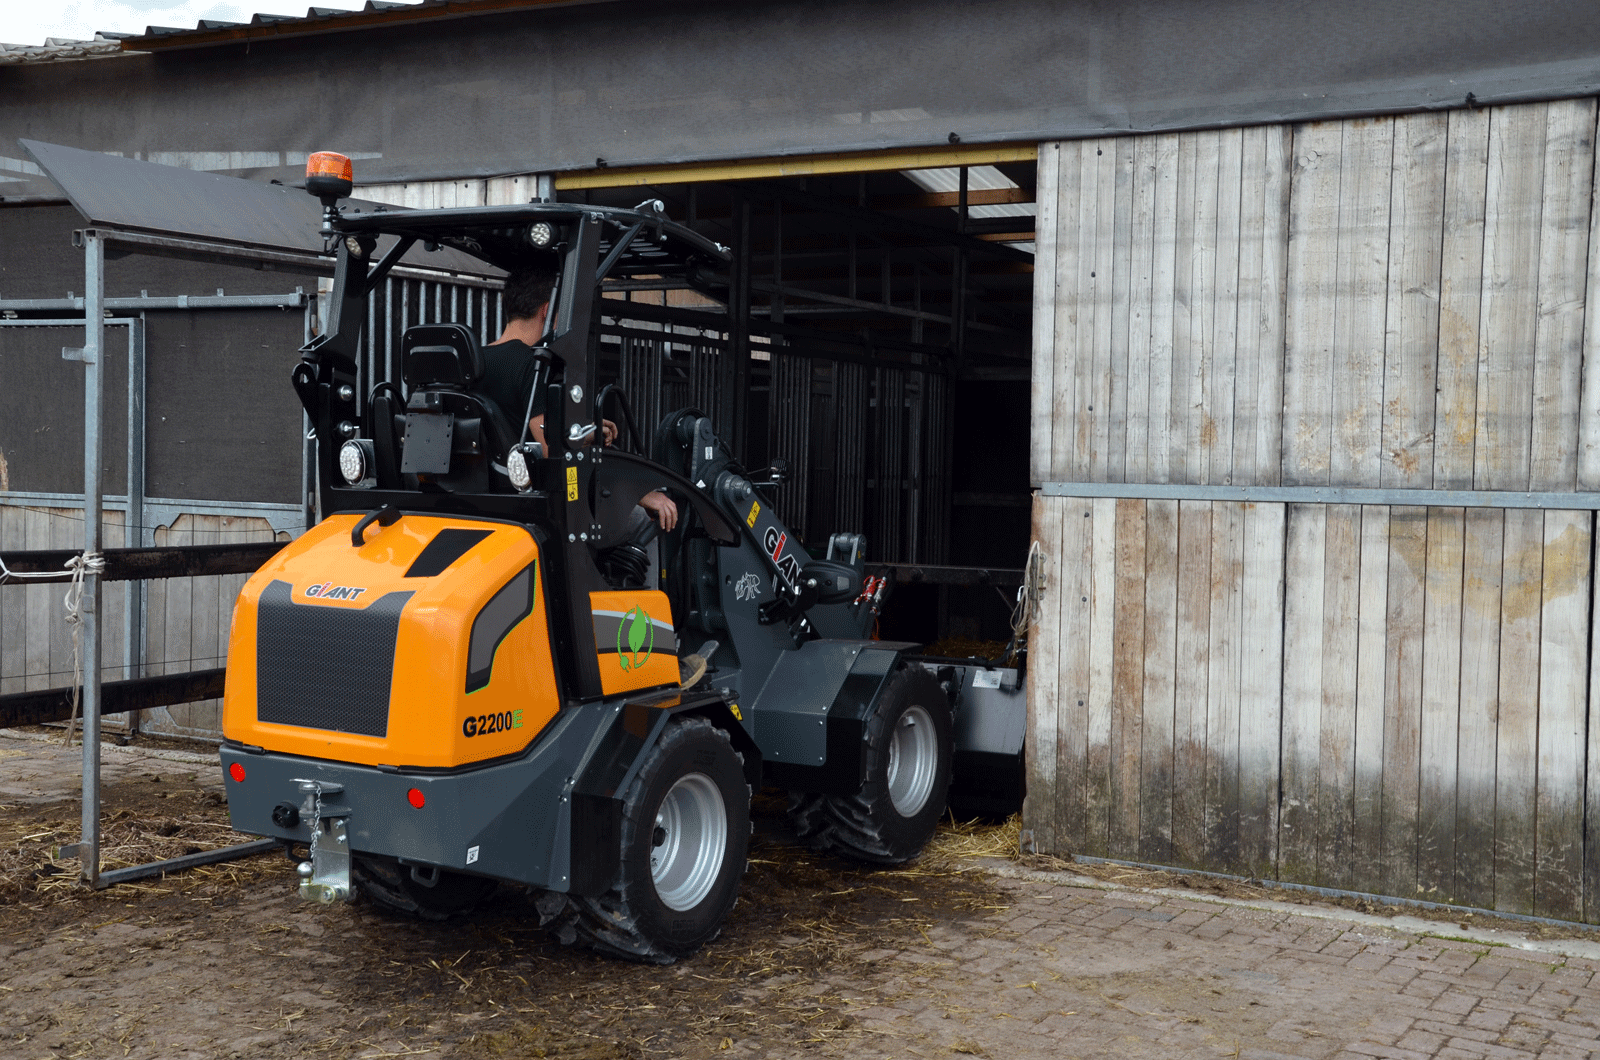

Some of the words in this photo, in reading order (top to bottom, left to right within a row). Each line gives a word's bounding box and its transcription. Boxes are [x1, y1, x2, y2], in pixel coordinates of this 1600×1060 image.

[764, 526, 802, 595] GIAN
[305, 582, 367, 601] GIANT
[462, 709, 524, 738] G2200E
